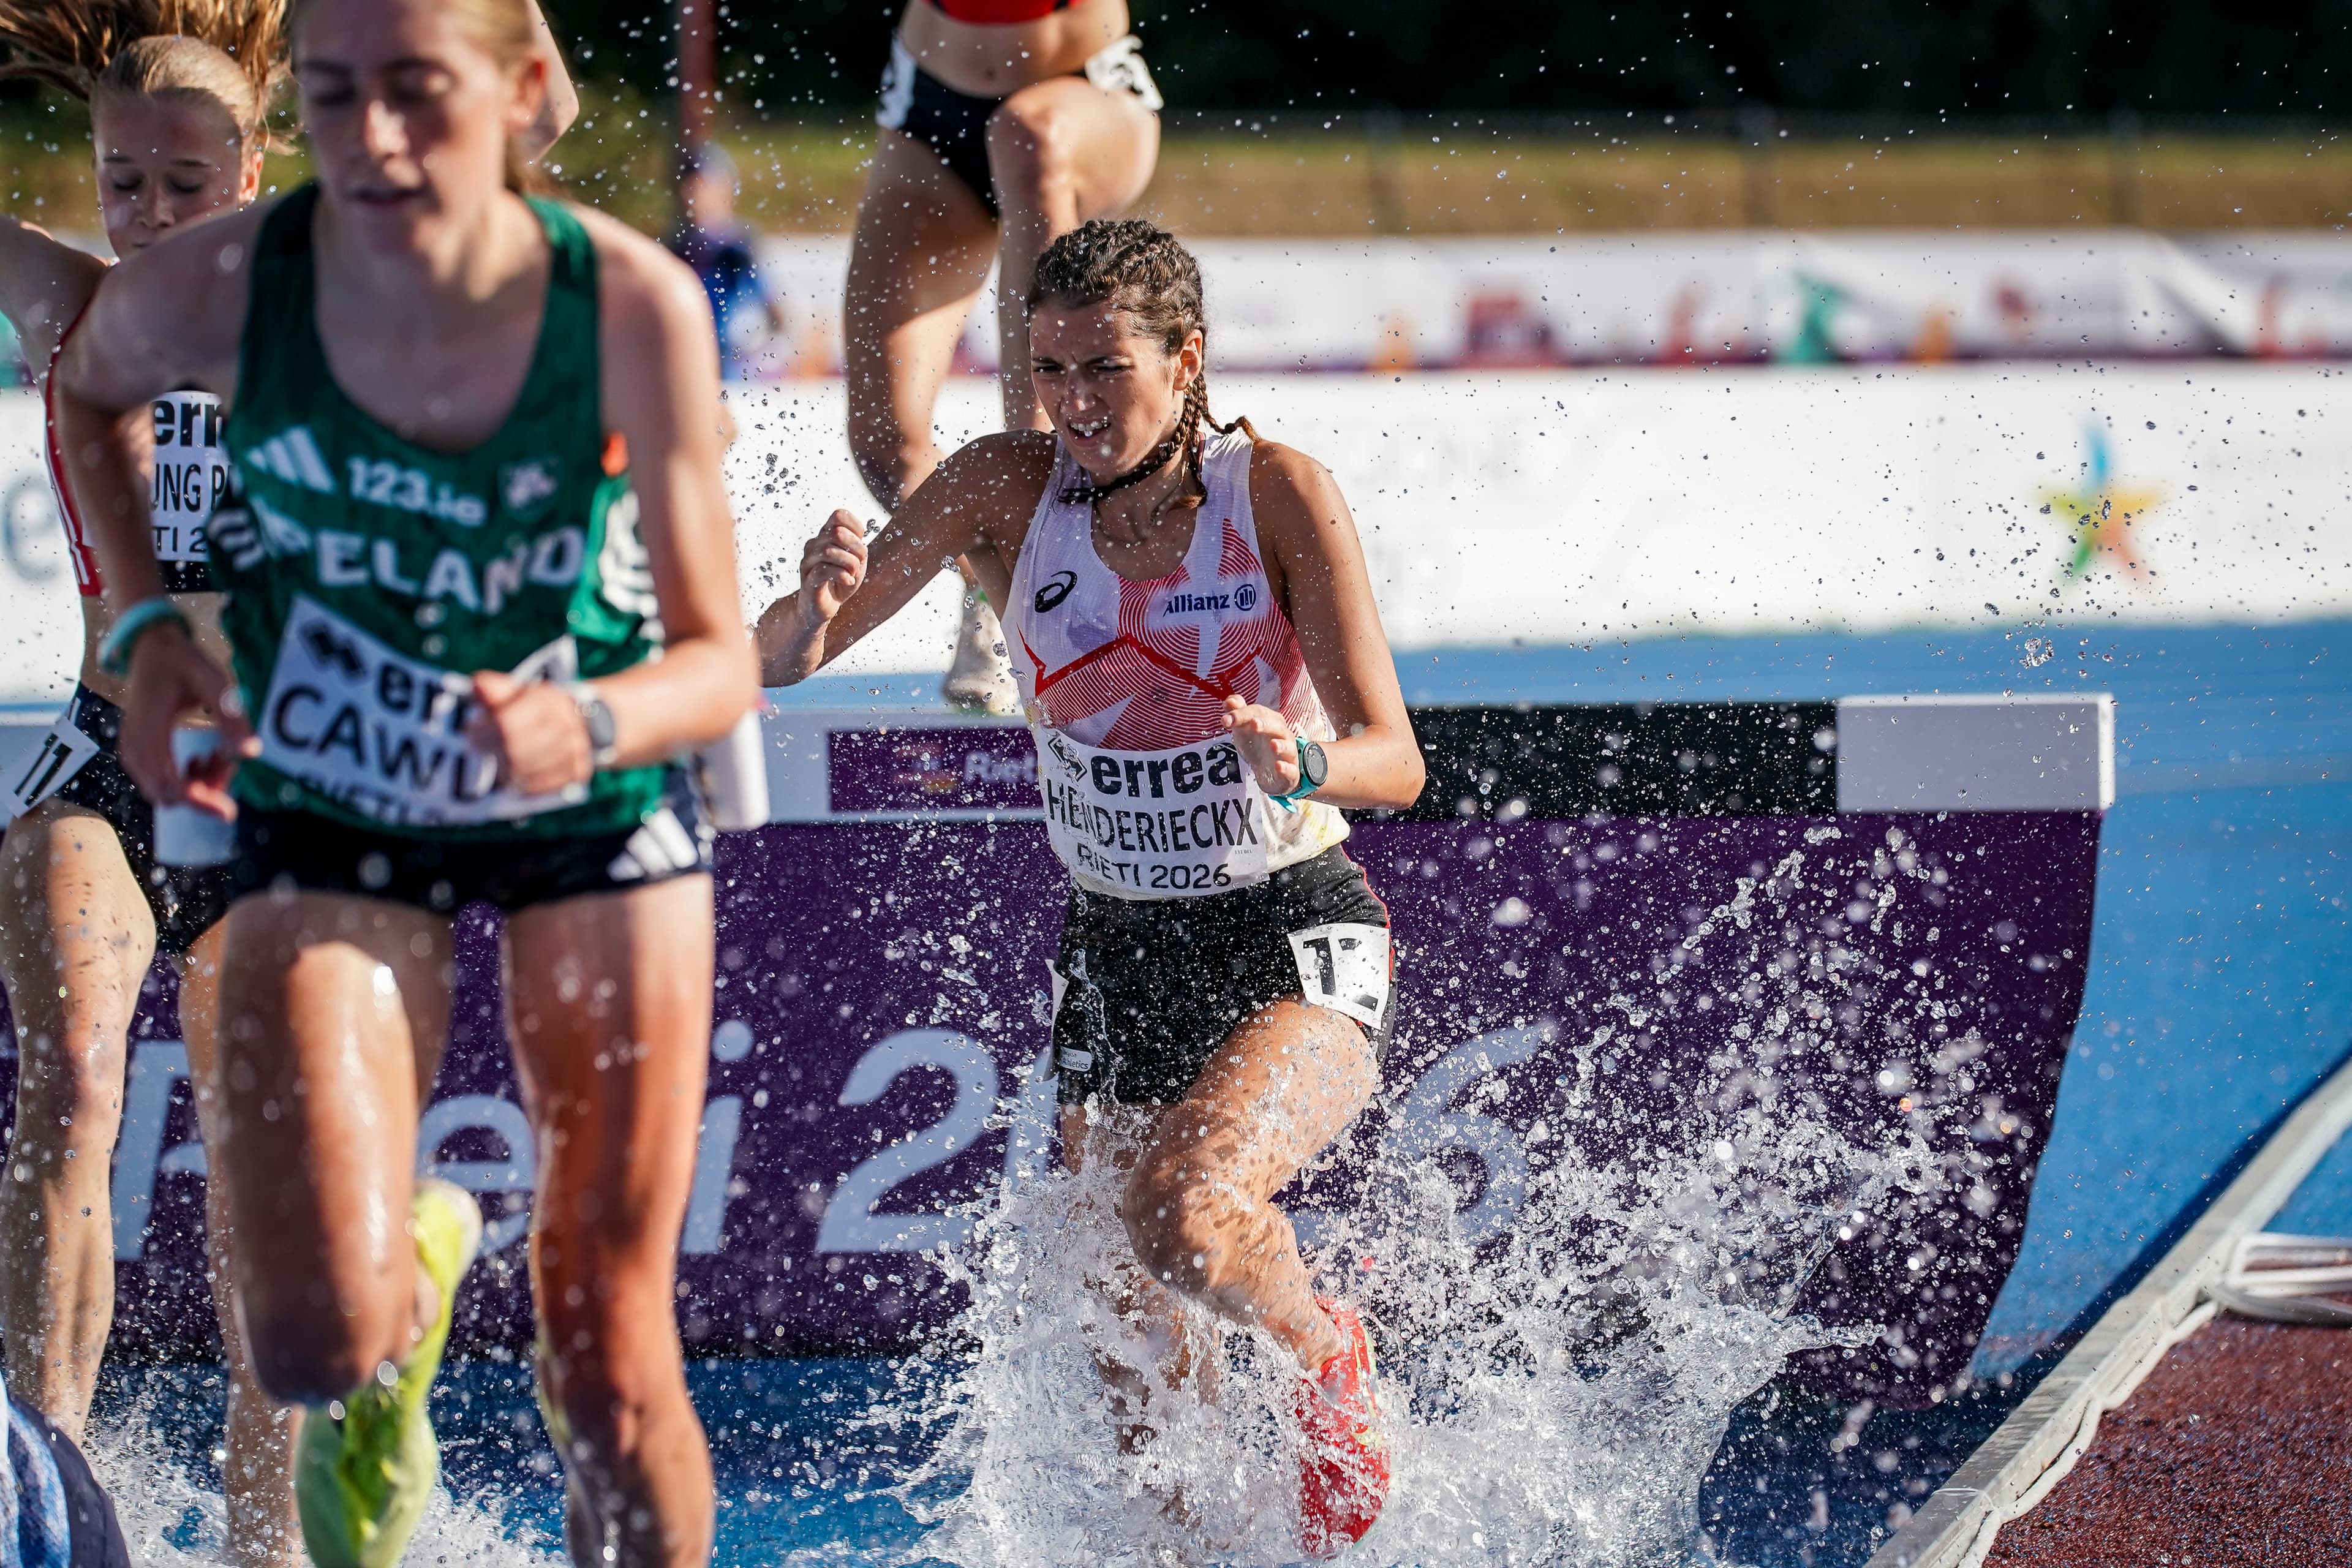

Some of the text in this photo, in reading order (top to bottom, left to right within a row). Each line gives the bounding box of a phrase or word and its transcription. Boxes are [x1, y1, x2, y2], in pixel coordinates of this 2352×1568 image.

[153, 400, 223, 448] err
[344, 456, 488, 527] 123.ie
[1163, 594, 1231, 617] Allianz
[13, 732, 74, 807] 11
[1046, 778, 1258, 853] HENDERIECKX
[1077, 842, 1232, 889] RIETI 2026
